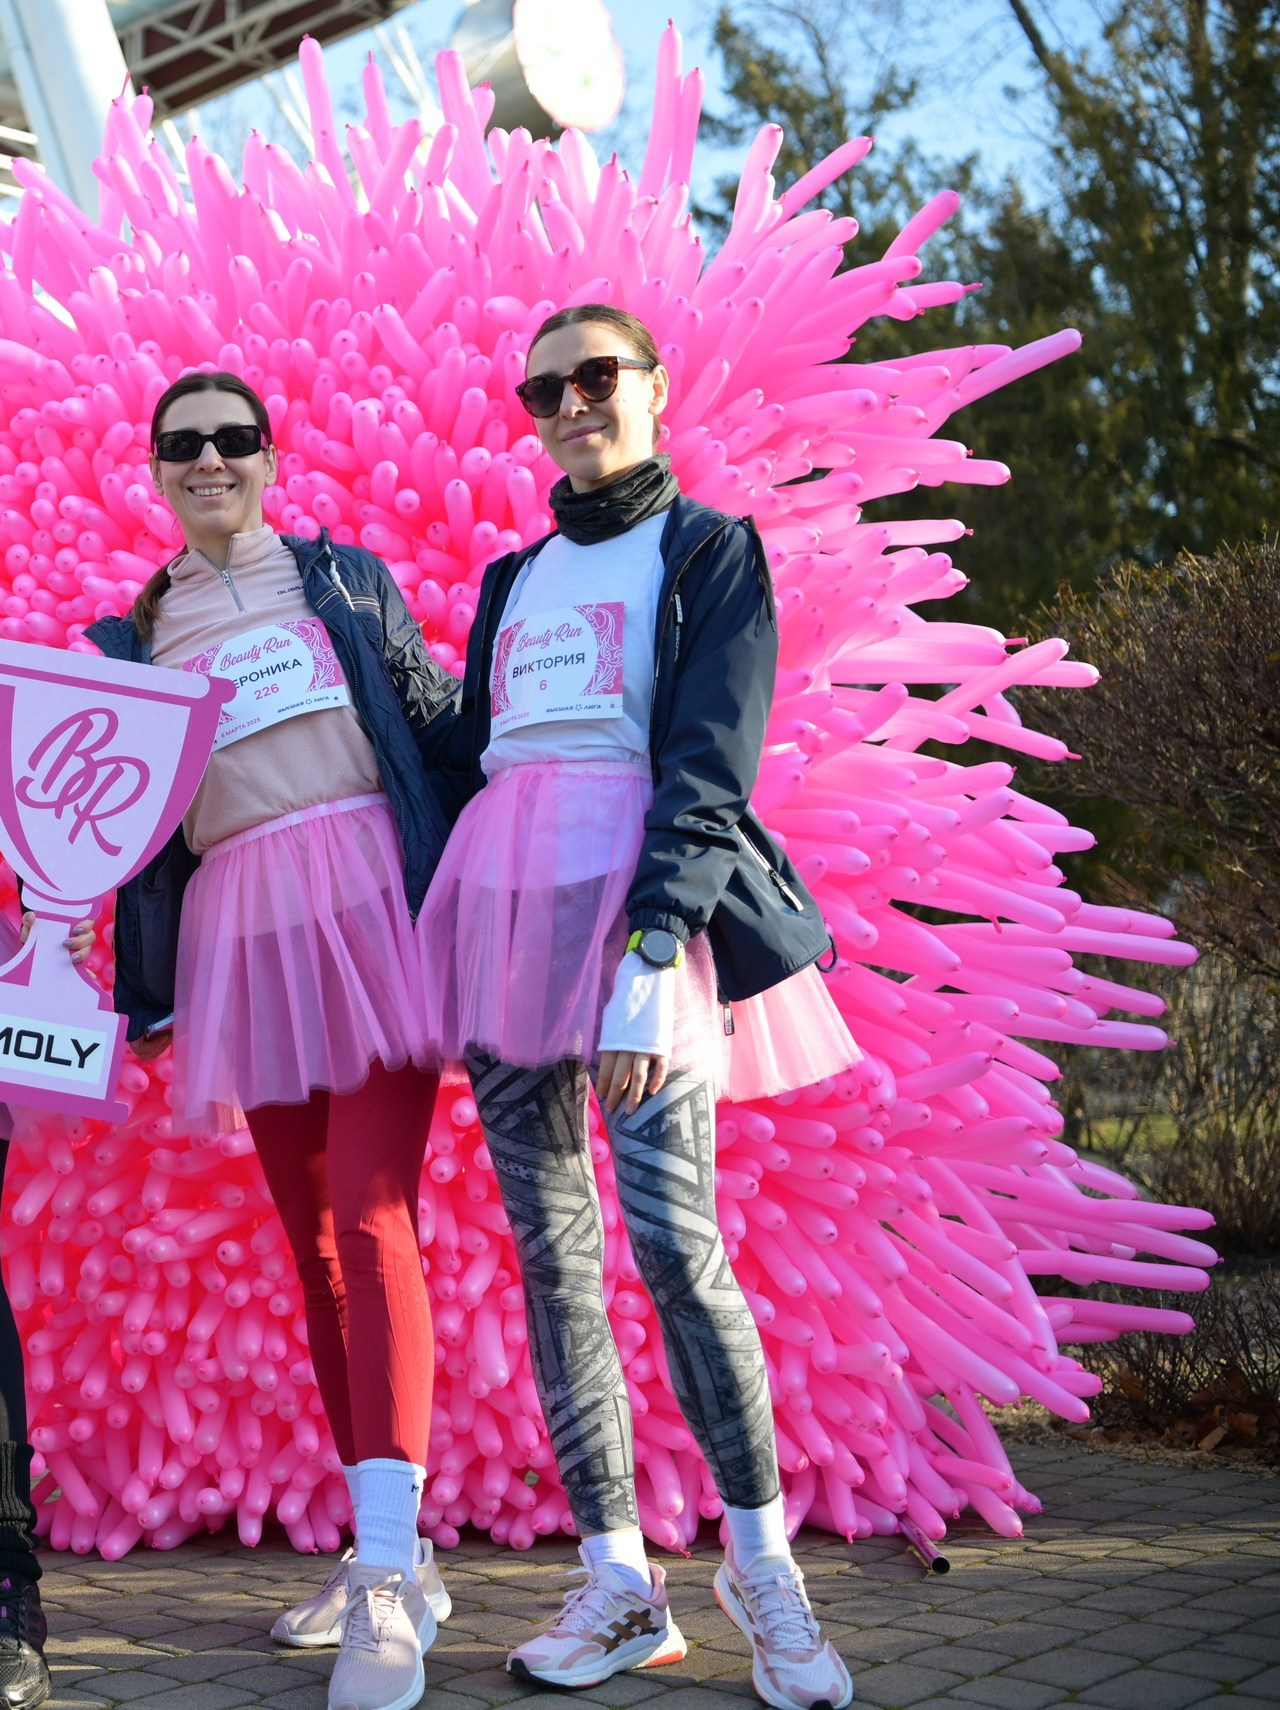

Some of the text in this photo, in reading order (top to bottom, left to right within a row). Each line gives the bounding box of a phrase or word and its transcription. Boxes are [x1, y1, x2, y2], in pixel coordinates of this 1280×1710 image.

[517, 623, 583, 652] Beauty Run
[220, 636, 292, 671] Beauty Run
[512, 652, 585, 678] ВИКТОРИЯ
[231, 658, 303, 689] ЕРОНИКА
[539, 680, 548, 691] 6
[254, 683, 280, 700] 226
[277, 701, 304, 713] ВЫСШАЯ
[225, 723, 247, 736] МАРТА
[15, 707, 151, 857] BR
